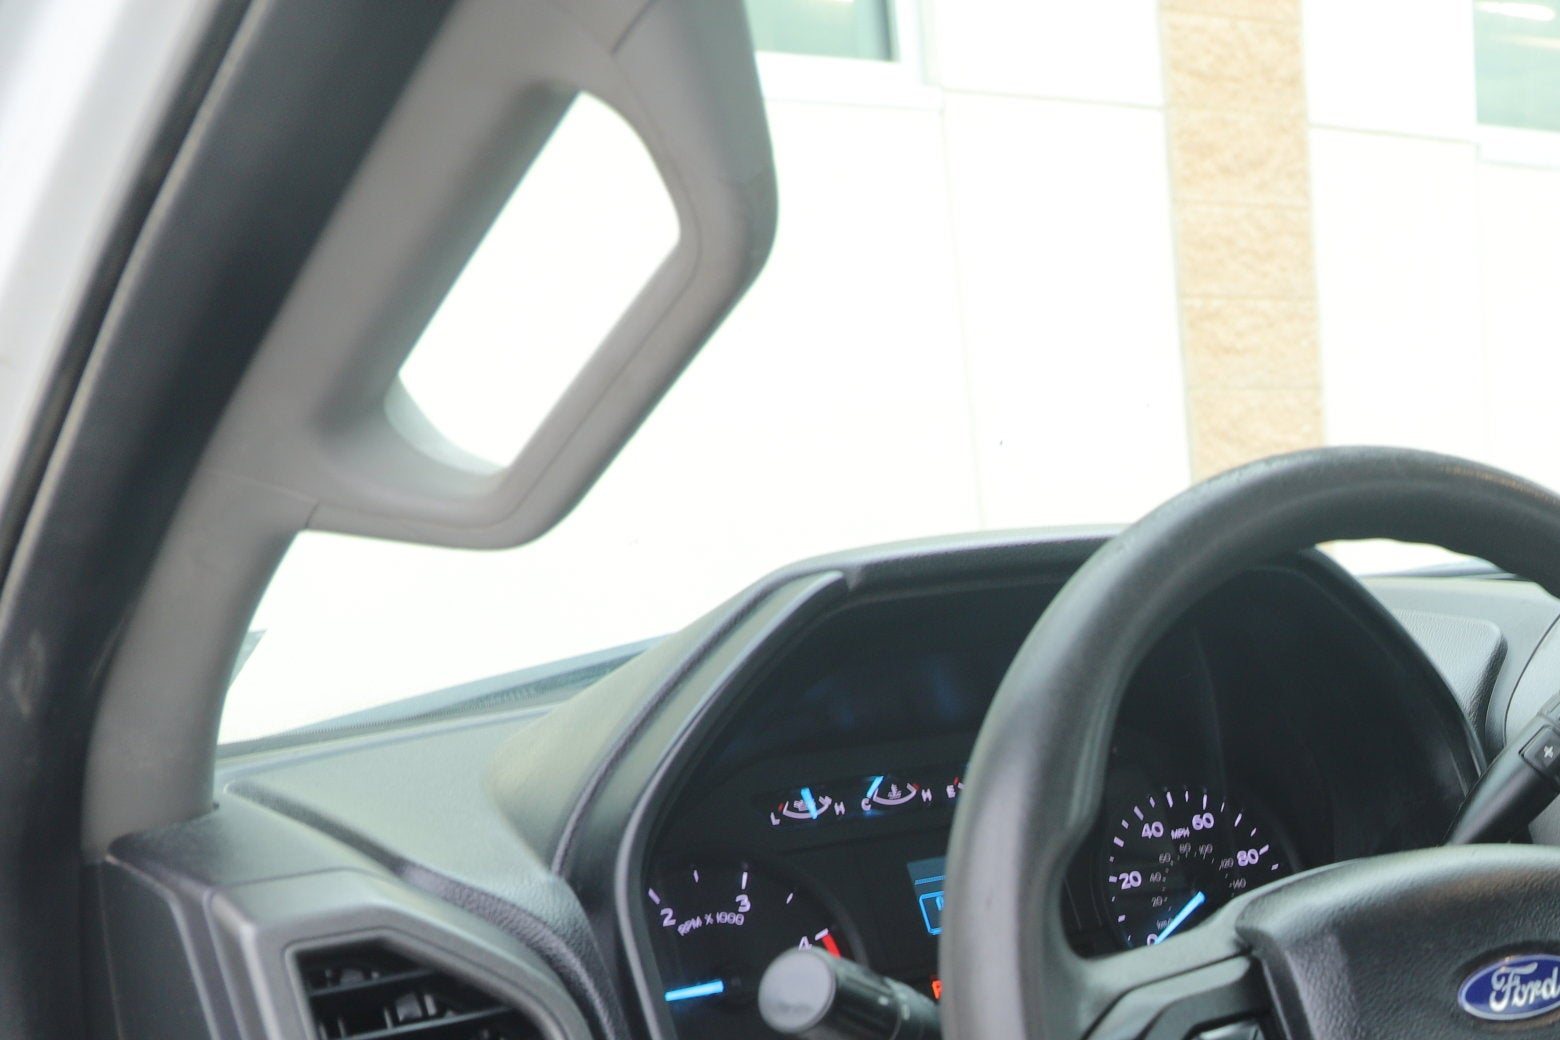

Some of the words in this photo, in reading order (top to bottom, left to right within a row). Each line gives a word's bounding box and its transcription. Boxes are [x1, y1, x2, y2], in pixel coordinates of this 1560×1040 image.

[1142, 822, 1164, 839] 40
[1192, 813, 1215, 831] 60
[1171, 827, 1190, 840] MPH
[1237, 848, 1259, 866] 80
[1119, 871, 1142, 890] 20
[736, 894, 751, 912] 3
[660, 908, 676, 927] 2
[677, 916, 703, 936] RPM
[716, 912, 745, 926] 1000
